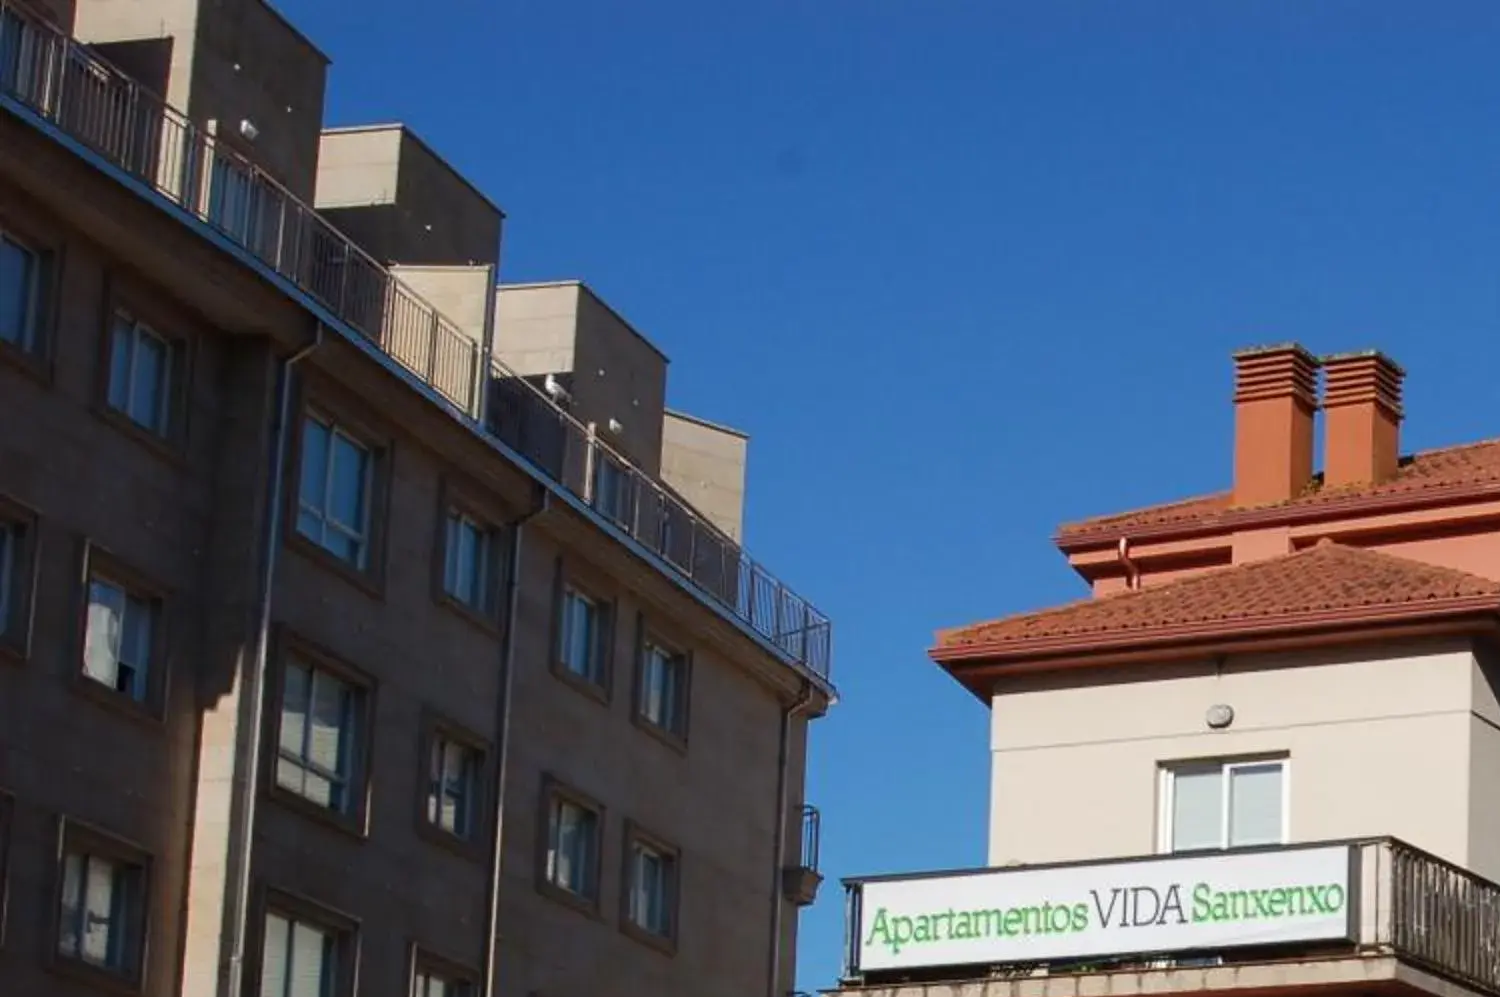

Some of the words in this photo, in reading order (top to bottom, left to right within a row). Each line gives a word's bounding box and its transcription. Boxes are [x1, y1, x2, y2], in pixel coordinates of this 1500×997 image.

[865, 901, 1090, 955] Apartamentos
[1090, 884, 1188, 928] VIDA
[1191, 882, 1345, 922] Sanxenxo
